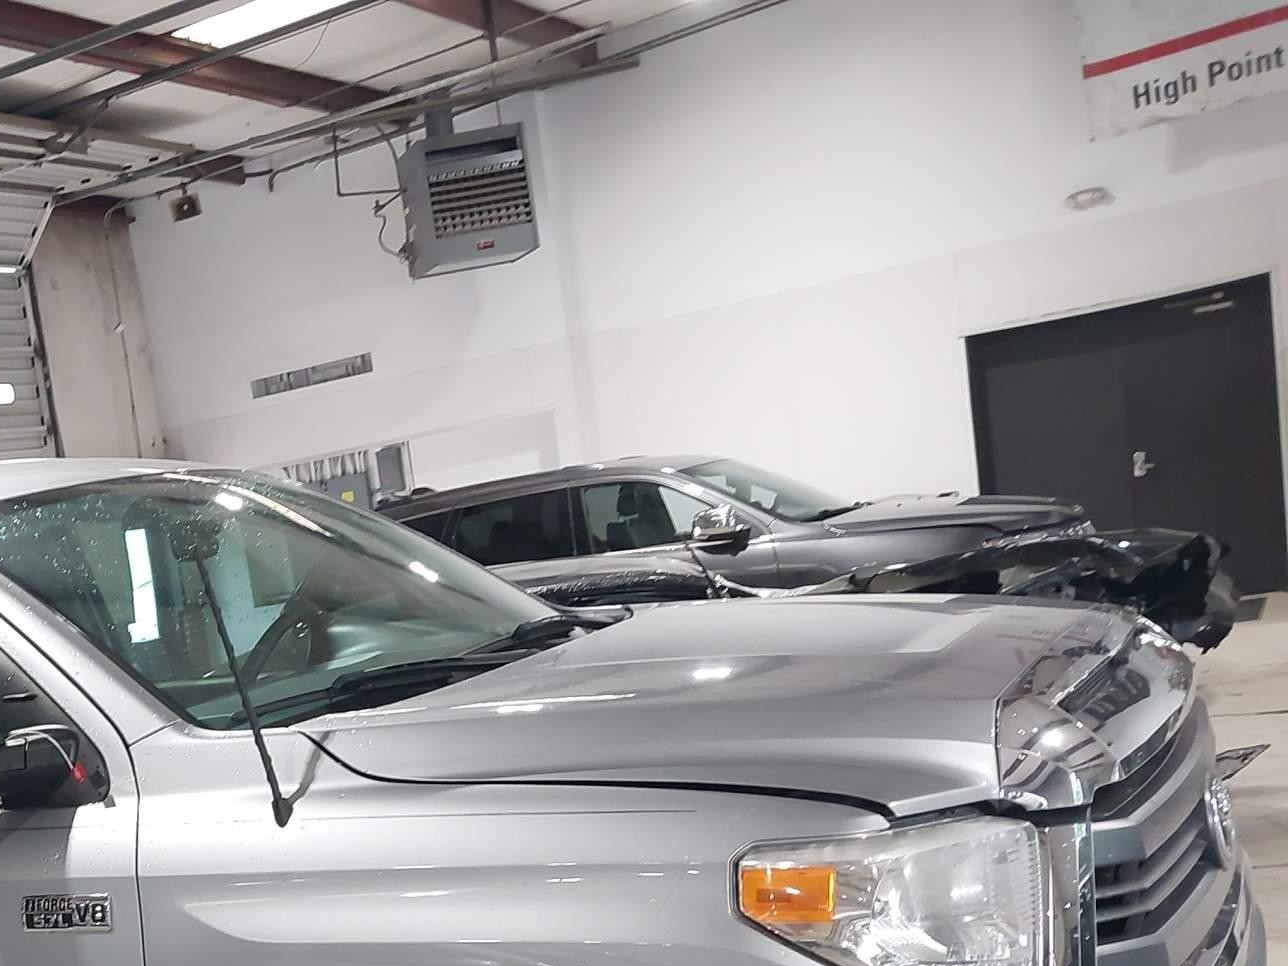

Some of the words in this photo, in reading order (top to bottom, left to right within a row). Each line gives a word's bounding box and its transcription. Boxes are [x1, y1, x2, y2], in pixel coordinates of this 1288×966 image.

[1132, 70, 1198, 110] High
[1207, 45, 1287, 88] Point
[74, 901, 107, 924] V8
